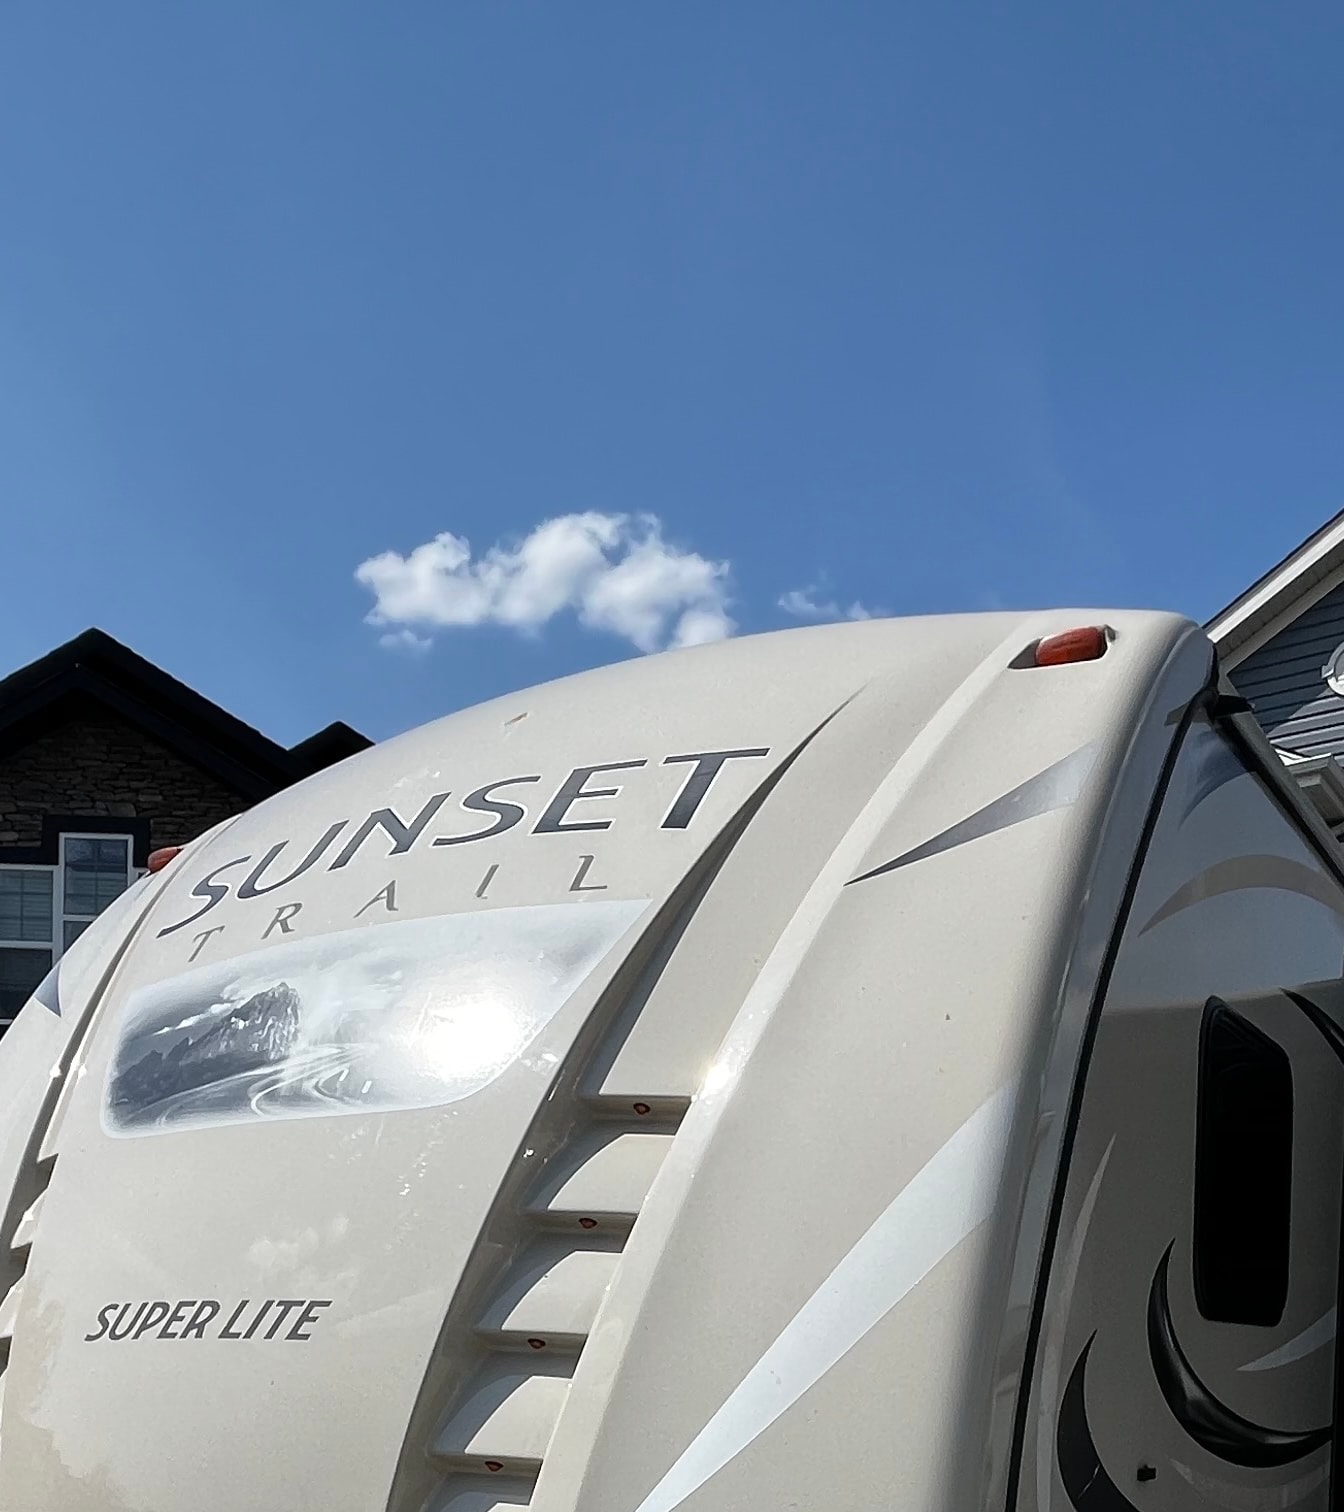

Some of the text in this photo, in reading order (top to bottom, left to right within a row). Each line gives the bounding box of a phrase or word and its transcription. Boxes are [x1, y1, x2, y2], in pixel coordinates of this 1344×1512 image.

[156, 746, 771, 939] SUNSET
[187, 854, 609, 963] TRAIL
[84, 1299, 333, 1342] SUPER LITE
